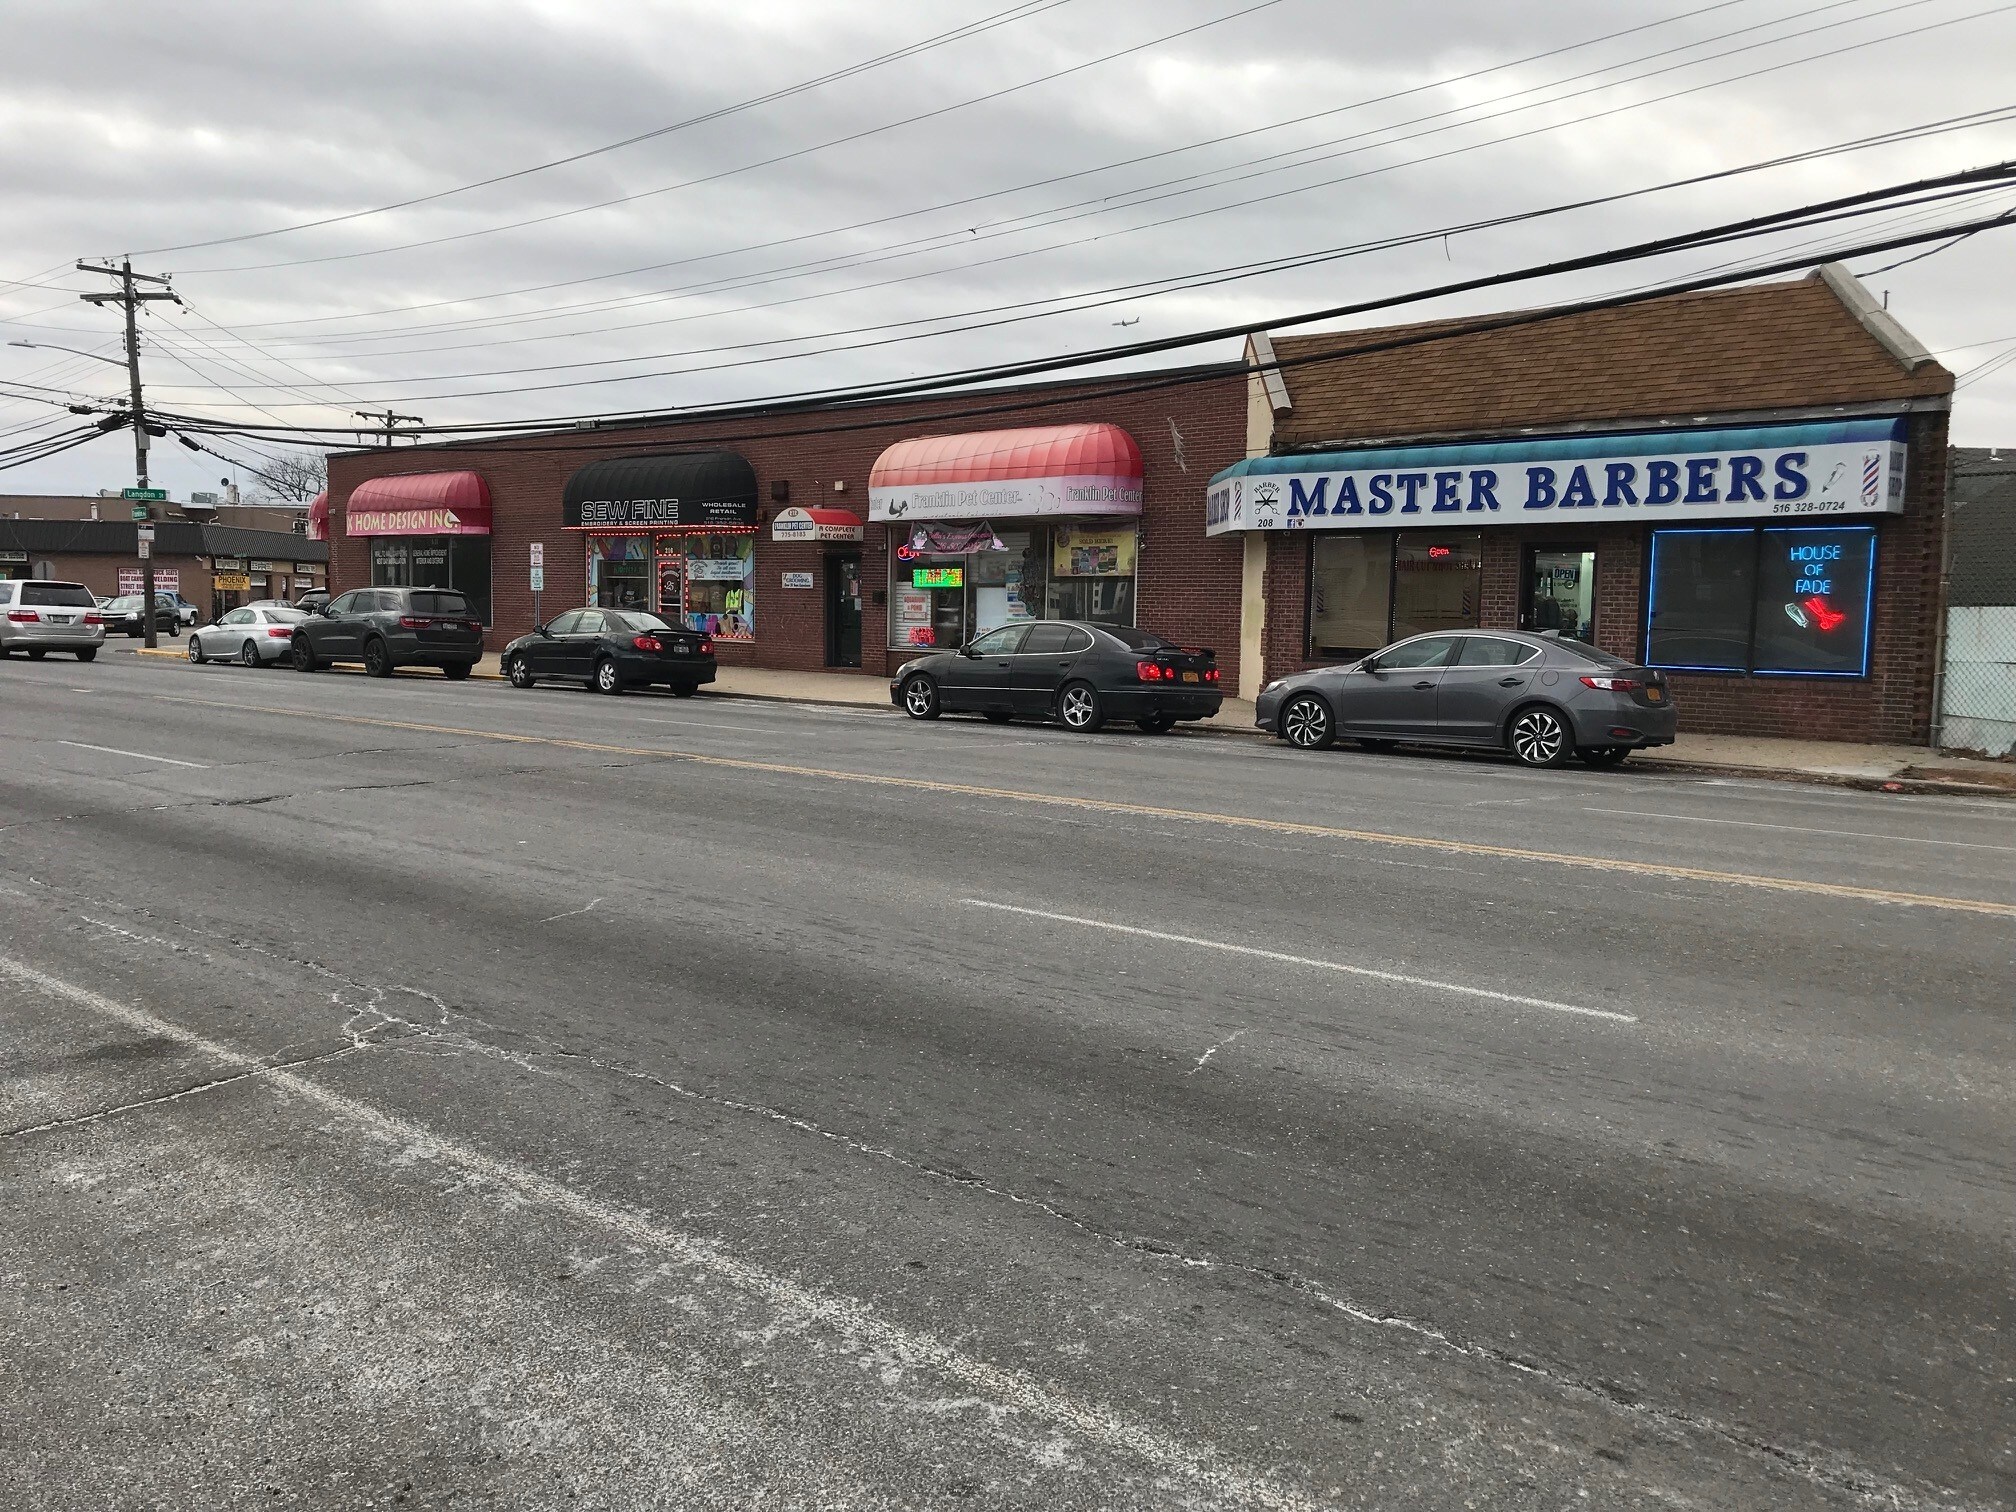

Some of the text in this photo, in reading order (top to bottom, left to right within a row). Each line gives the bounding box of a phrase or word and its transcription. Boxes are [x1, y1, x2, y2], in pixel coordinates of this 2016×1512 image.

[1254, 482, 1280, 493] BARBER
[1287, 453, 1809, 517] MASTER BARBERS
[127, 490, 156, 500] Langdon
[911, 488, 1018, 509] Franklin Pet Center
[1067, 485, 1143, 503] Franklin Pet Center
[581, 498, 679, 520] SEW FINE
[1772, 501, 1846, 514] 516 328-0724
[356, 513, 386, 531] HOME
[389, 510, 426, 530] DESIGN
[791, 522, 799, 530] PET
[1257, 518, 1274, 528] 208
[825, 525, 855, 533] COMPLETE
[1790, 545, 1841, 561] HOUSE
[1804, 563, 1824, 576] OF
[218, 575, 246, 584] PHOENIX
[1795, 579, 1832, 595] FADE
